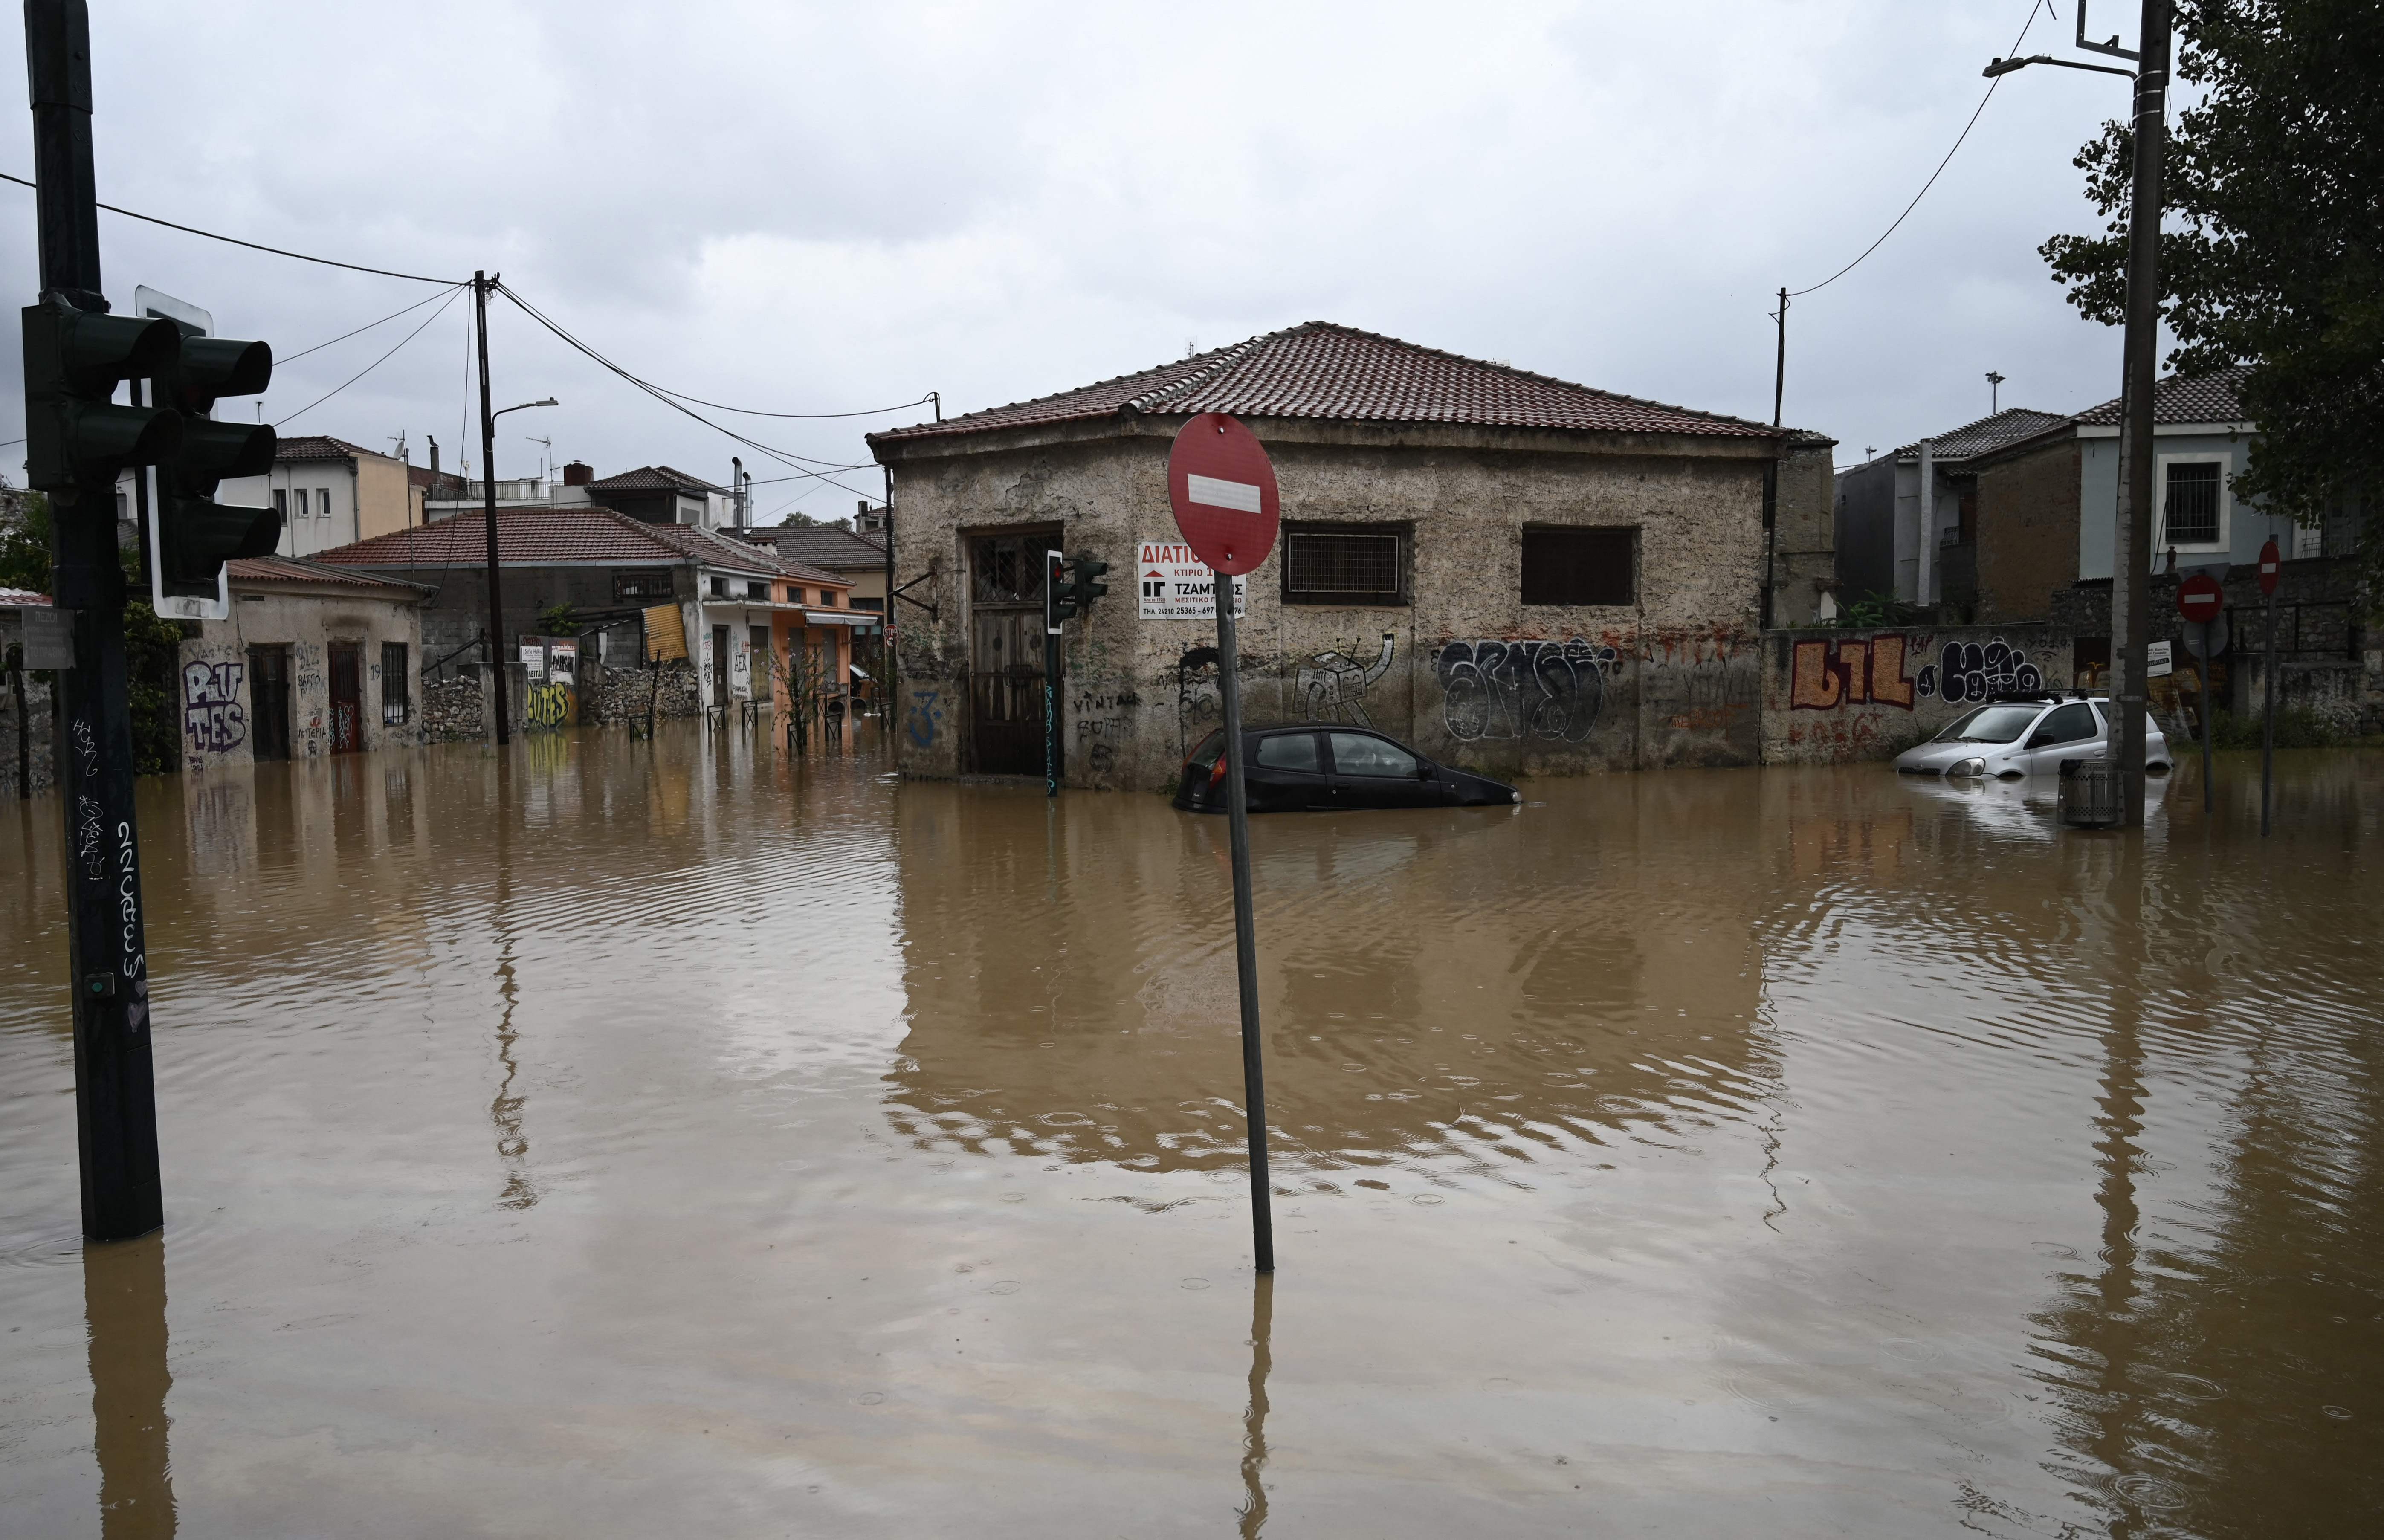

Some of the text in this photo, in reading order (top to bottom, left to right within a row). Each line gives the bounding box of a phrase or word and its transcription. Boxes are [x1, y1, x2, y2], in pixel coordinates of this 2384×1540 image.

[1175, 583, 1243, 595] ΤΖΑΜΤΣ
[885, 628, 897, 636] STOP
[371, 664, 381, 681] 19
[528, 670, 542, 678] ΛΕΙΤΑΙ
